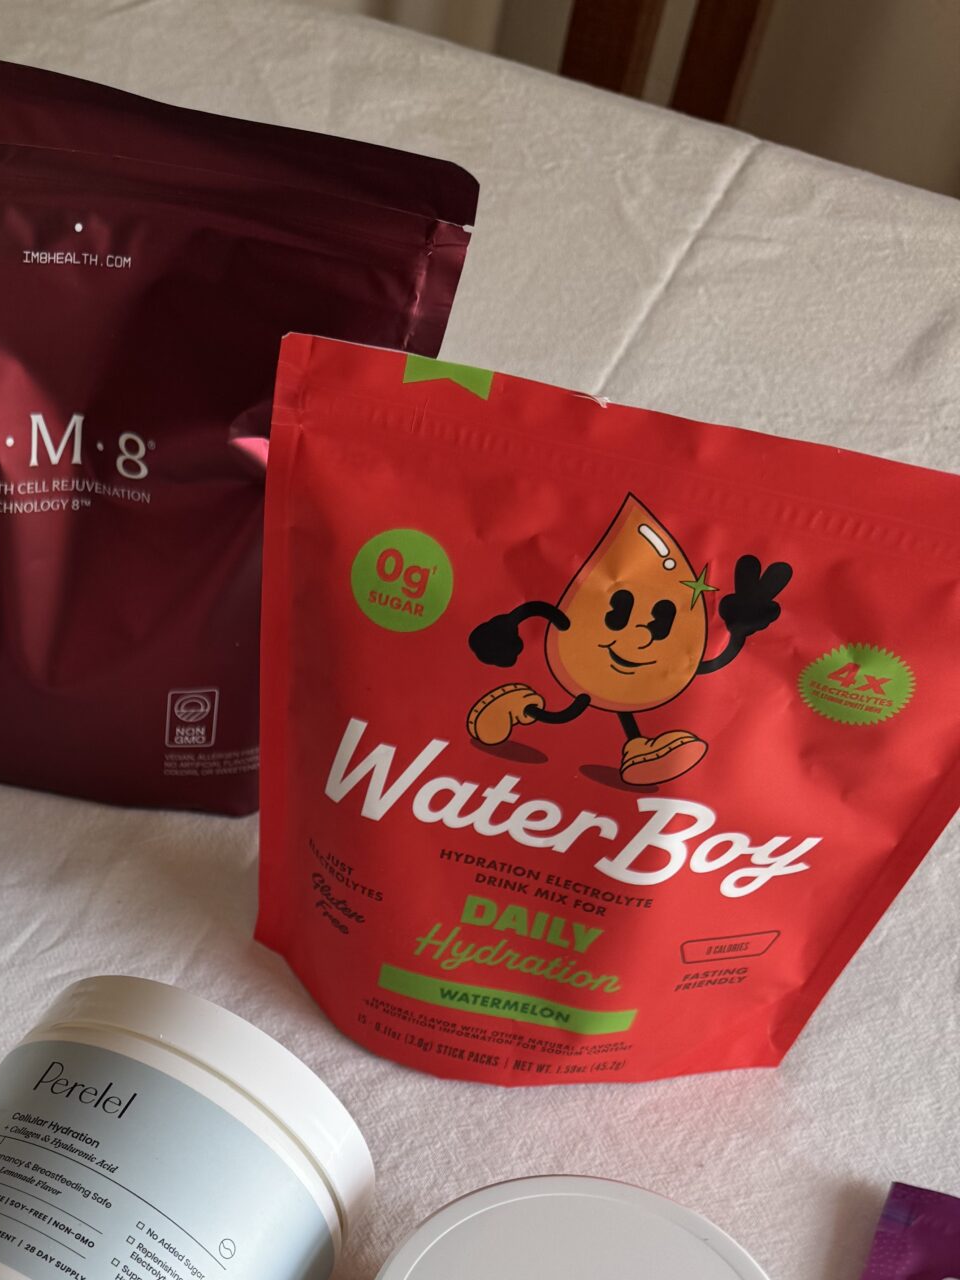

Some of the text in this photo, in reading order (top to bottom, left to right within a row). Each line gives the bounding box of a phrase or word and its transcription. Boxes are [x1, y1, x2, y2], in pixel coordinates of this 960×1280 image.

[23, 251, 131, 268] IM8HEALTH.COM
[17, 480, 49, 495] CELL
[52, 478, 151, 505] REJUVENATION
[368, 590, 425, 617] SUGAR
[439, 848, 654, 909] HYDRATION ELECTROLYTE
[475, 872, 607, 917] DRINK MIX FOR
[460, 894, 604, 955] DAILY
[414, 922, 621, 994] Hydration
[682, 967, 748, 983] FASTING
[673, 975, 748, 992] FRIENDLY
[439, 986, 571, 1024] WATERMELON
[32, 1061, 138, 1119] Perelel
[11, 1112, 100, 1149] Cellular Hydration
[9, 1125, 119, 1175] Collagen Hyaluronic Acid
[30, 1162, 92, 1199] Breastfeeding
[90, 1191, 113, 1210] Safe
[34, 1178, 63, 1196] Flavor
[9, 1198, 49, 1223] SOY-FREE
[52, 1218, 96, 1249] NON-GMO
[24, 1242, 37, 1254] 28
[35, 1248, 56, 1265] DAY
[145, 1227, 159, 1242] No
[157, 1237, 186, 1263] Added
